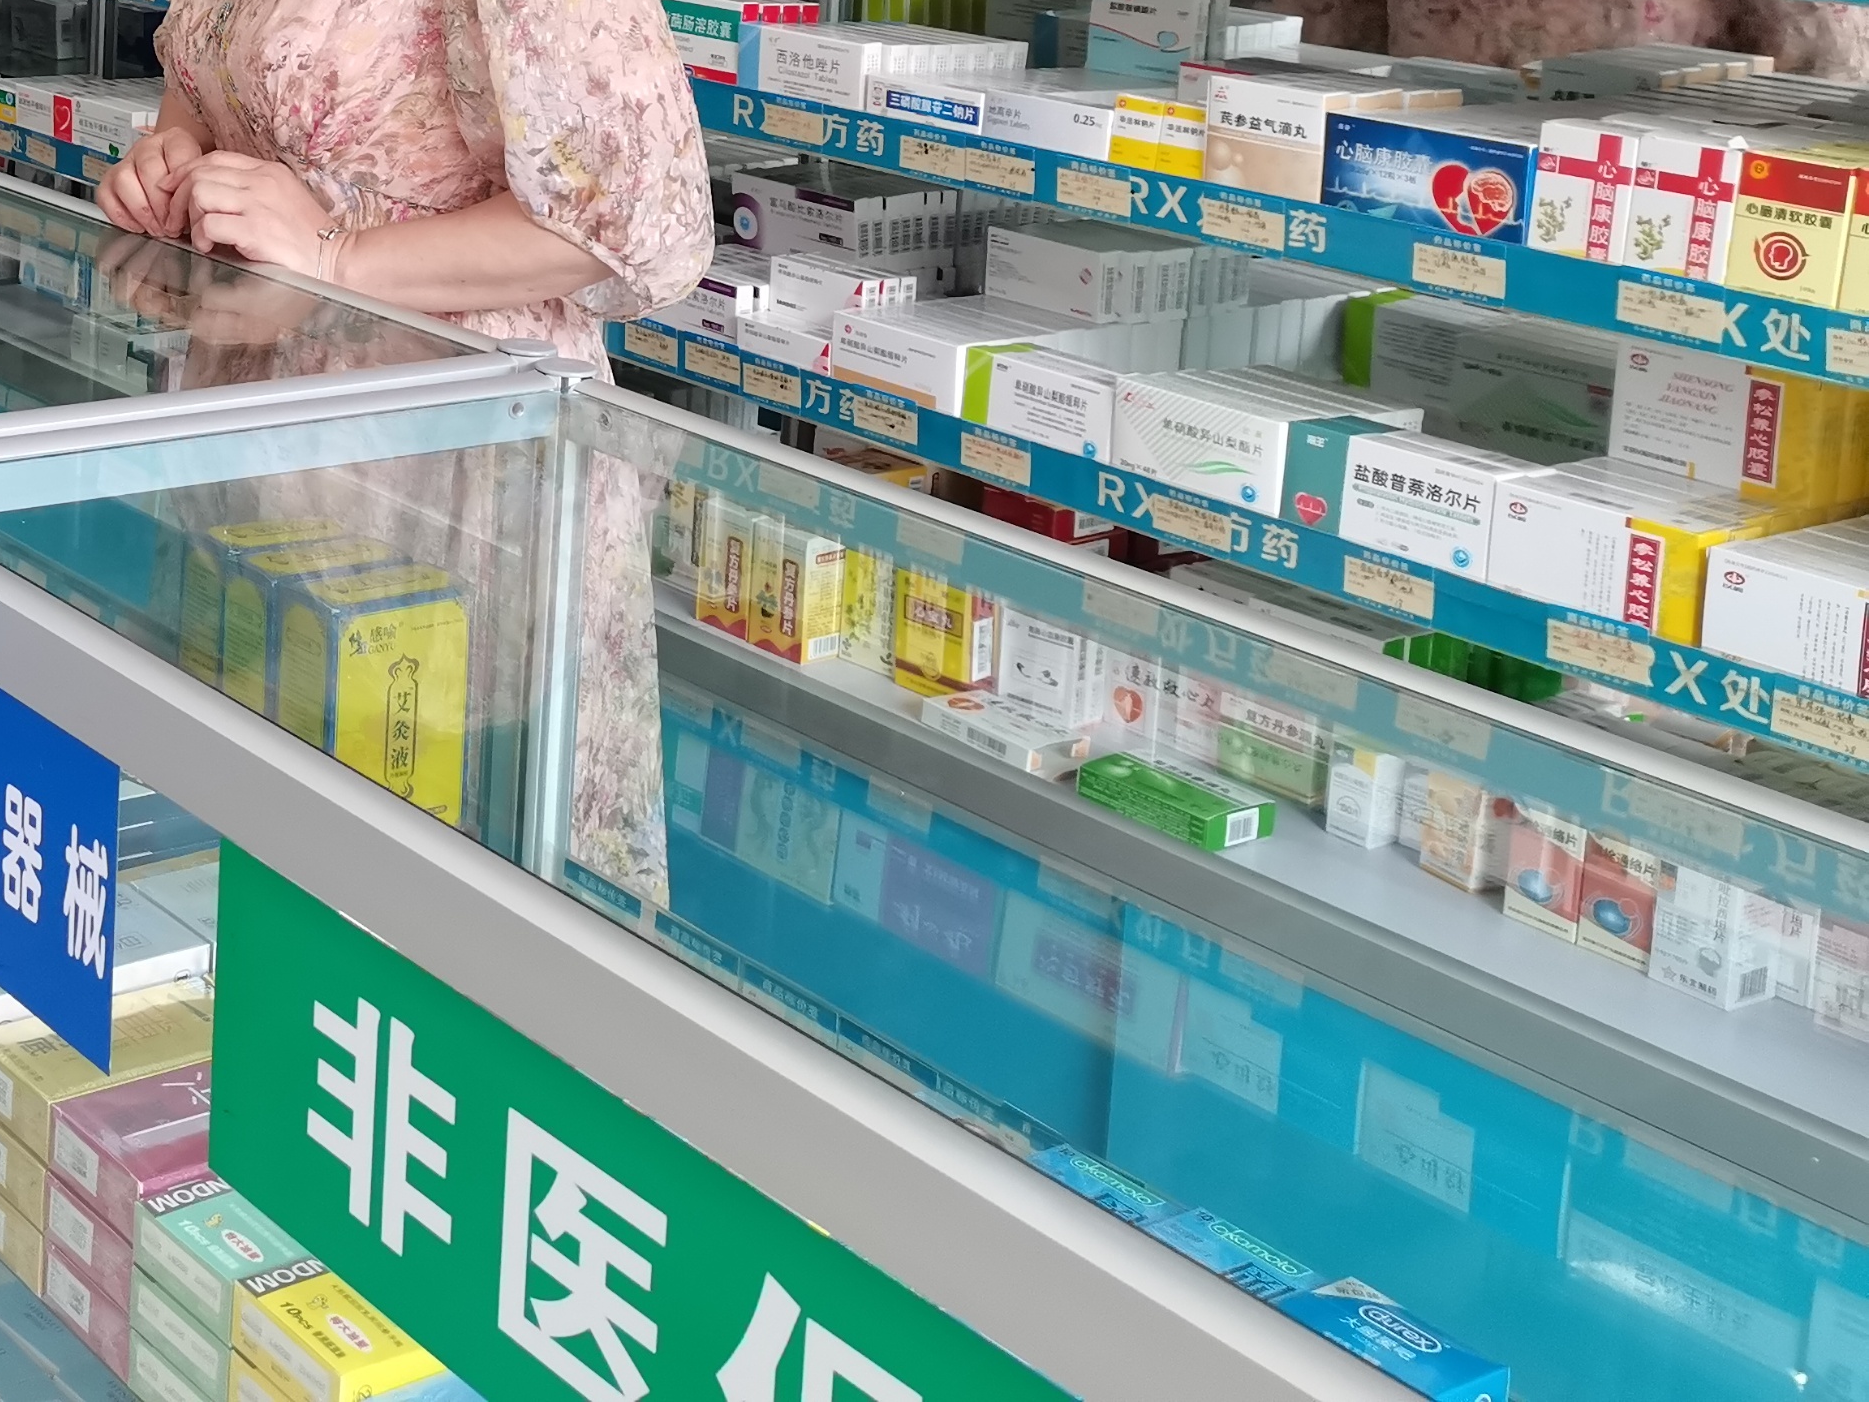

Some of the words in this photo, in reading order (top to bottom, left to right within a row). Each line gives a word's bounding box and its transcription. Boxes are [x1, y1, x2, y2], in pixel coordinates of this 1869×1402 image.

[775, 48, 841, 73] 西洛他唑片
[887, 91, 977, 121] 三磷酸腺苷二钠片
[1220, 110, 1309, 141] 芪参益气滴丸
[1335, 140, 1435, 179] 心脑康胶囊
[1745, 202, 1833, 230] 心脑清软胶囊
[1162, 416, 1264, 459] 单硝酸异山梨酯片
[1747, 387, 1775, 479] 参松养心胶囊
[1352, 463, 1481, 514] 盐酸普萘洛尔片
[390, 689, 414, 771] 艾灸液
[1073, 1155, 1162, 1208] okamoto
[1212, 1219, 1302, 1277] okamoto
[1365, 1306, 1437, 1348] durex
